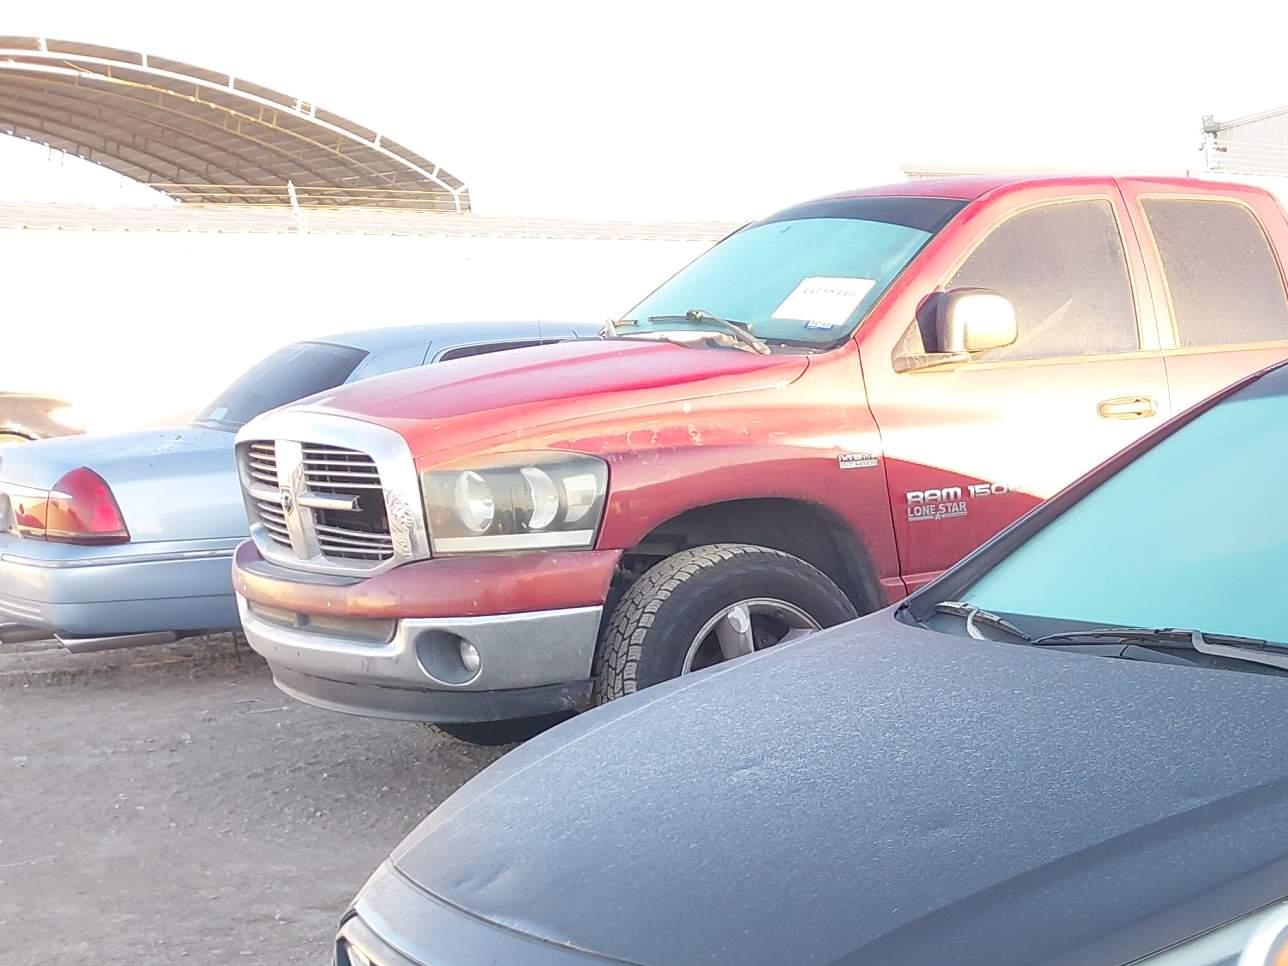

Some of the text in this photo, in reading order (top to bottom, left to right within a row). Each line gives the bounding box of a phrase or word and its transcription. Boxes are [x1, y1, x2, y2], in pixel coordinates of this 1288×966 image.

[906, 486, 962, 505] RAM
[907, 501, 967, 517] LONE STAR
